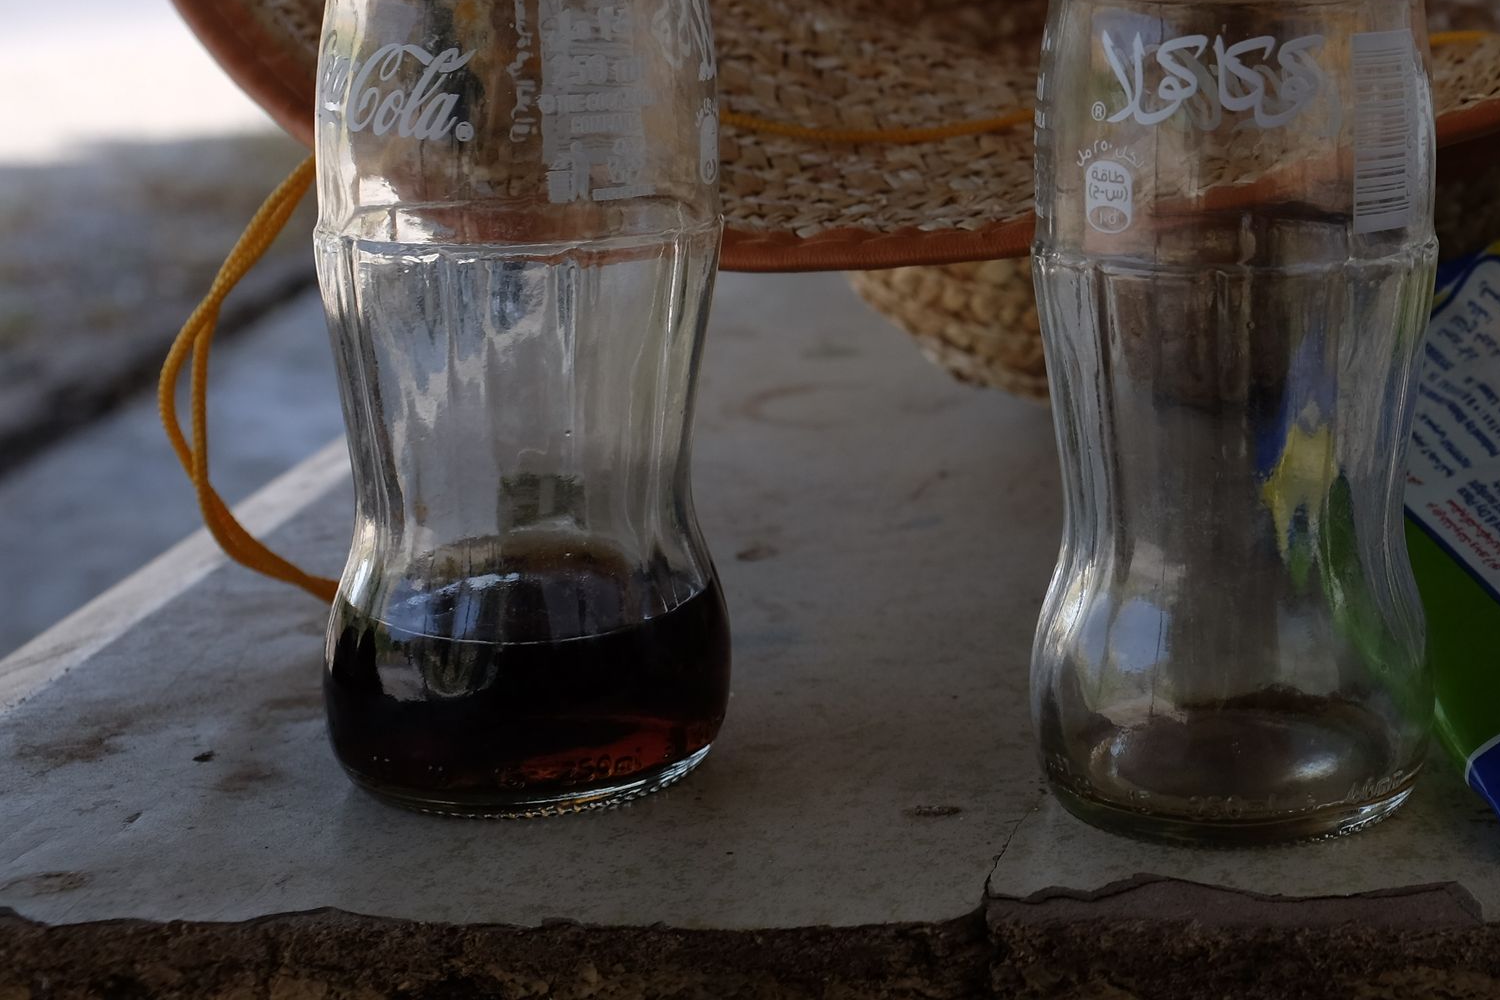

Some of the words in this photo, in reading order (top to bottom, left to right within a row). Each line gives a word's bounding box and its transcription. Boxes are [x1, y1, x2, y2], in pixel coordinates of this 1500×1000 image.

[1091, 166, 1125, 183] طاقة
[1457, 487, 1480, 507] Place
[1474, 503, 1493, 519] Dry
[1484, 514, 1499, 523] &
